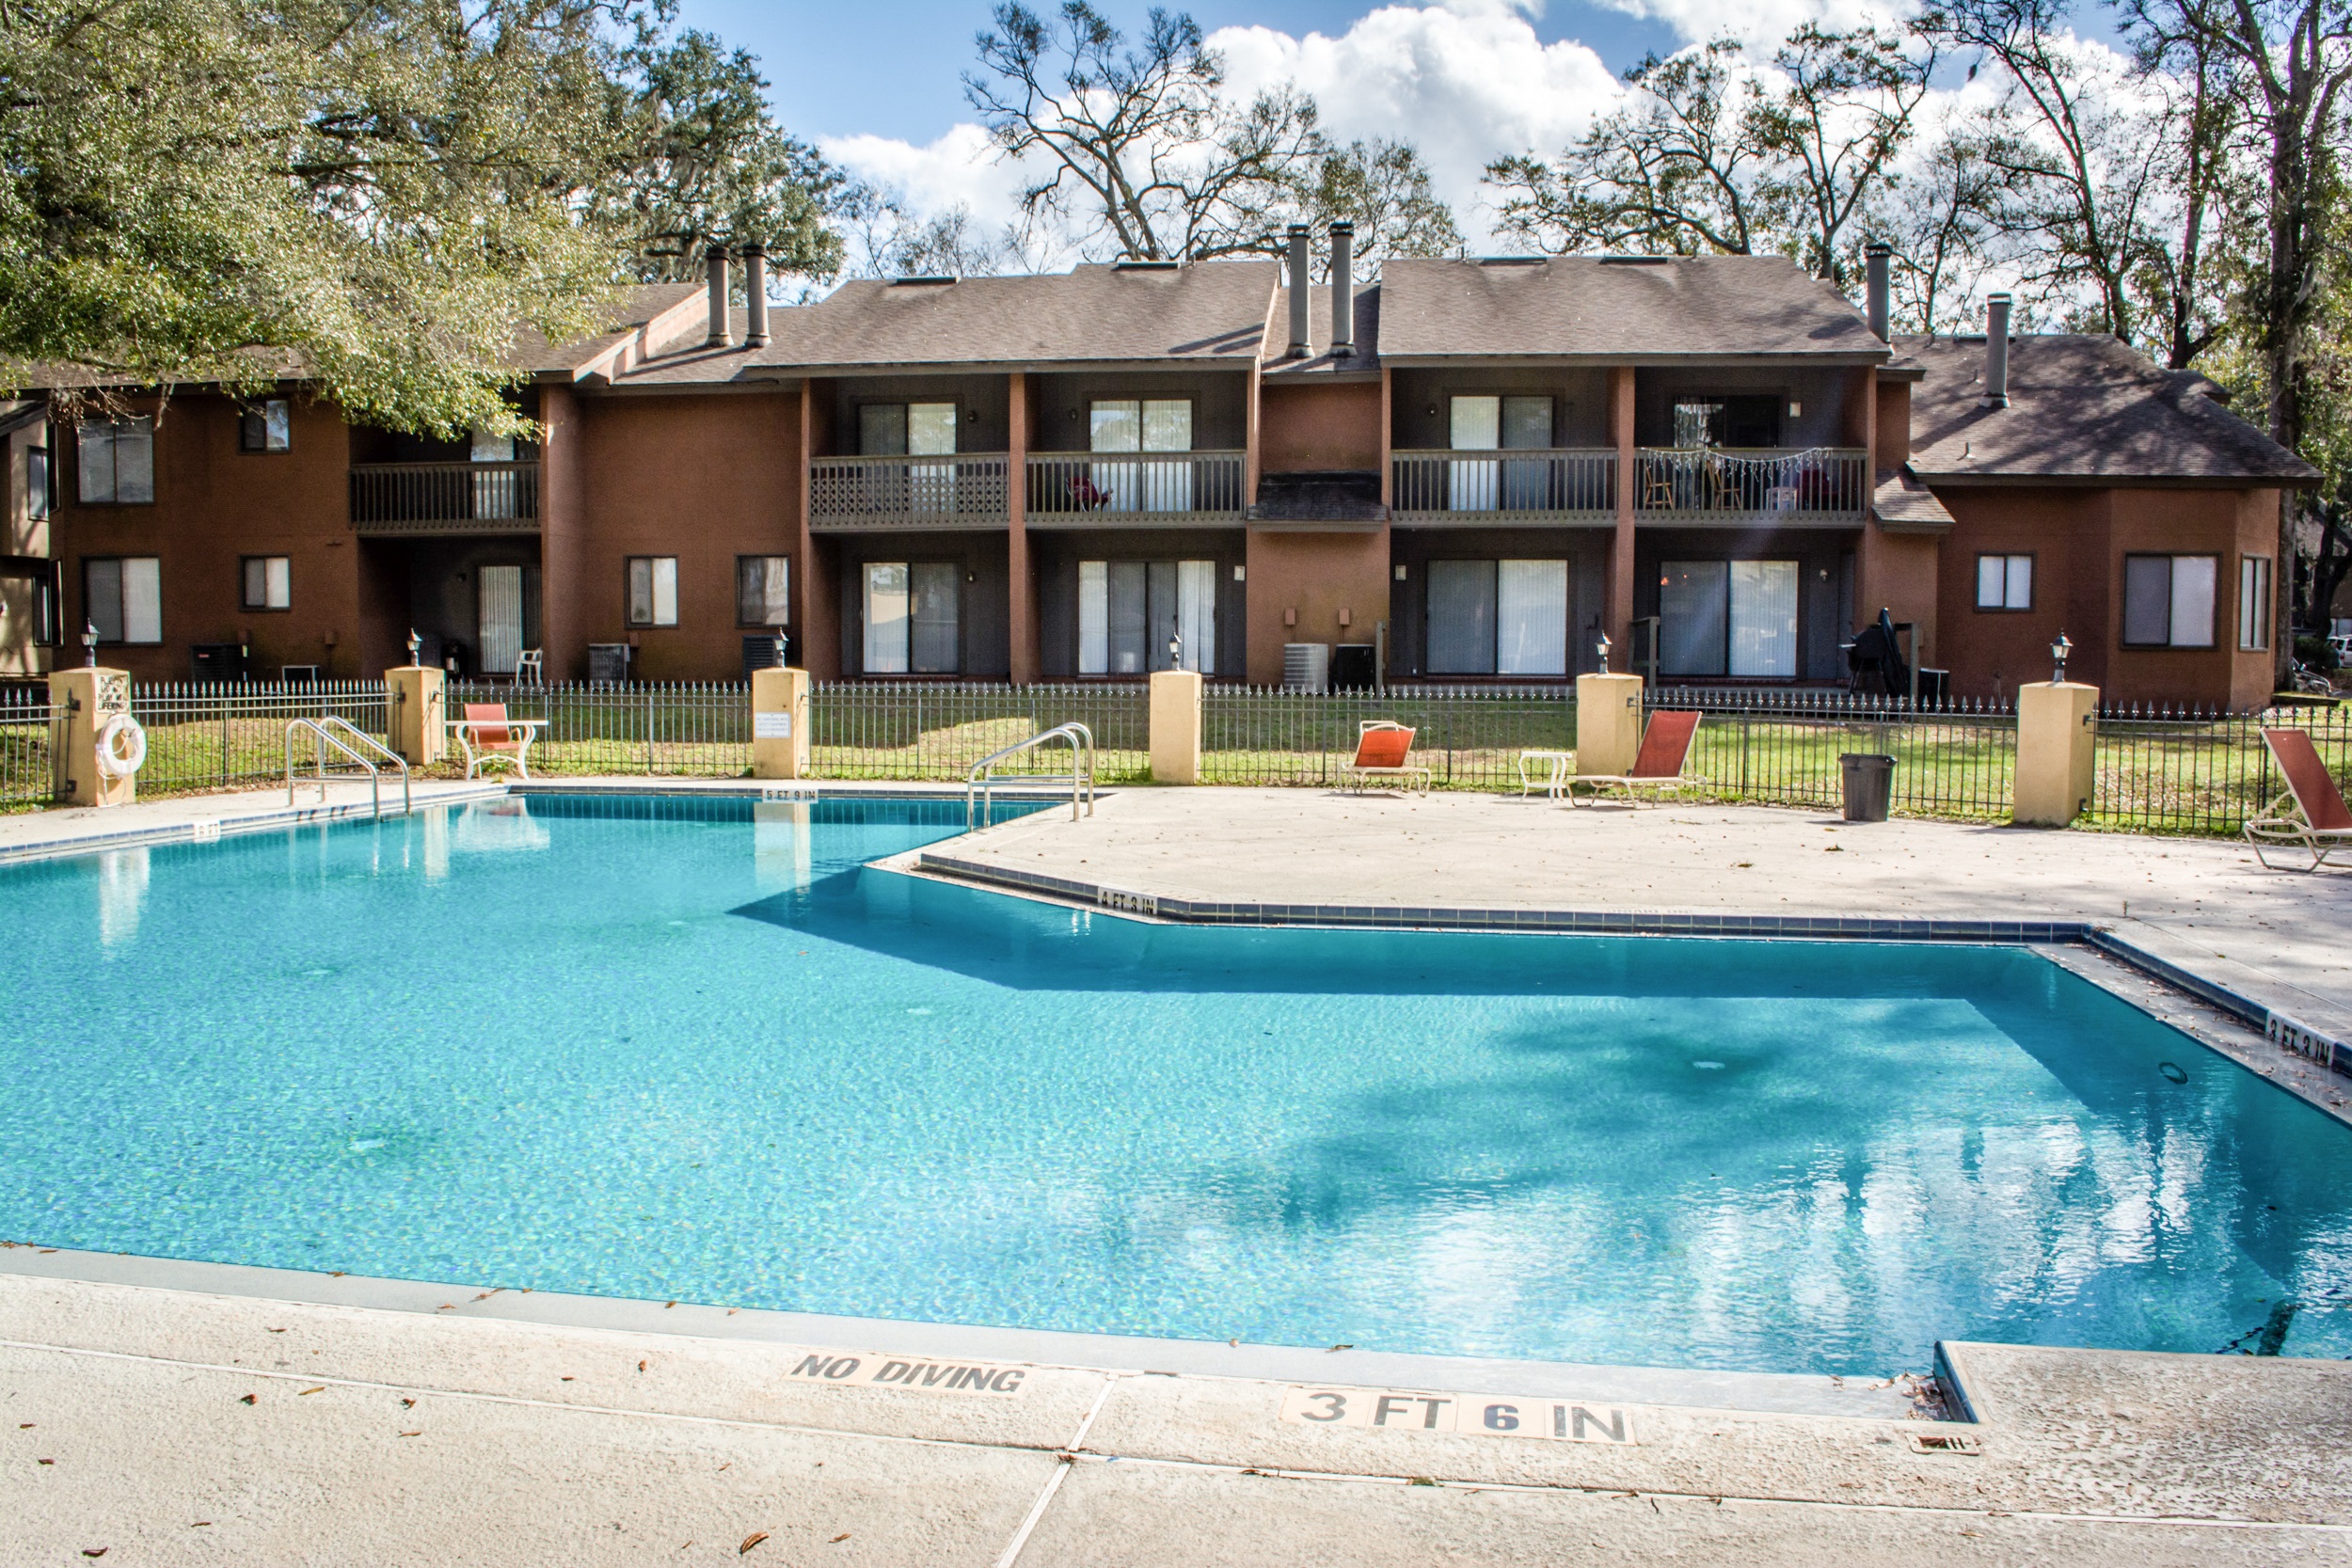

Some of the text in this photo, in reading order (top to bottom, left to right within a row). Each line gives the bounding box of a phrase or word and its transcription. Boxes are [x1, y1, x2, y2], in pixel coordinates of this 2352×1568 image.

[767, 790, 772, 800] 5
[777, 790, 789, 800] FT
[804, 790, 816, 800] IN
[1113, 893, 1125, 910] FT
[1142, 897, 1154, 915] IN
[2281, 1024, 2297, 1052] FT
[2315, 1039, 2330, 1064] IN
[790, 1354, 1025, 1393] NO DIVING
[1300, 1392, 1627, 1442] 3 FT 6 IN
